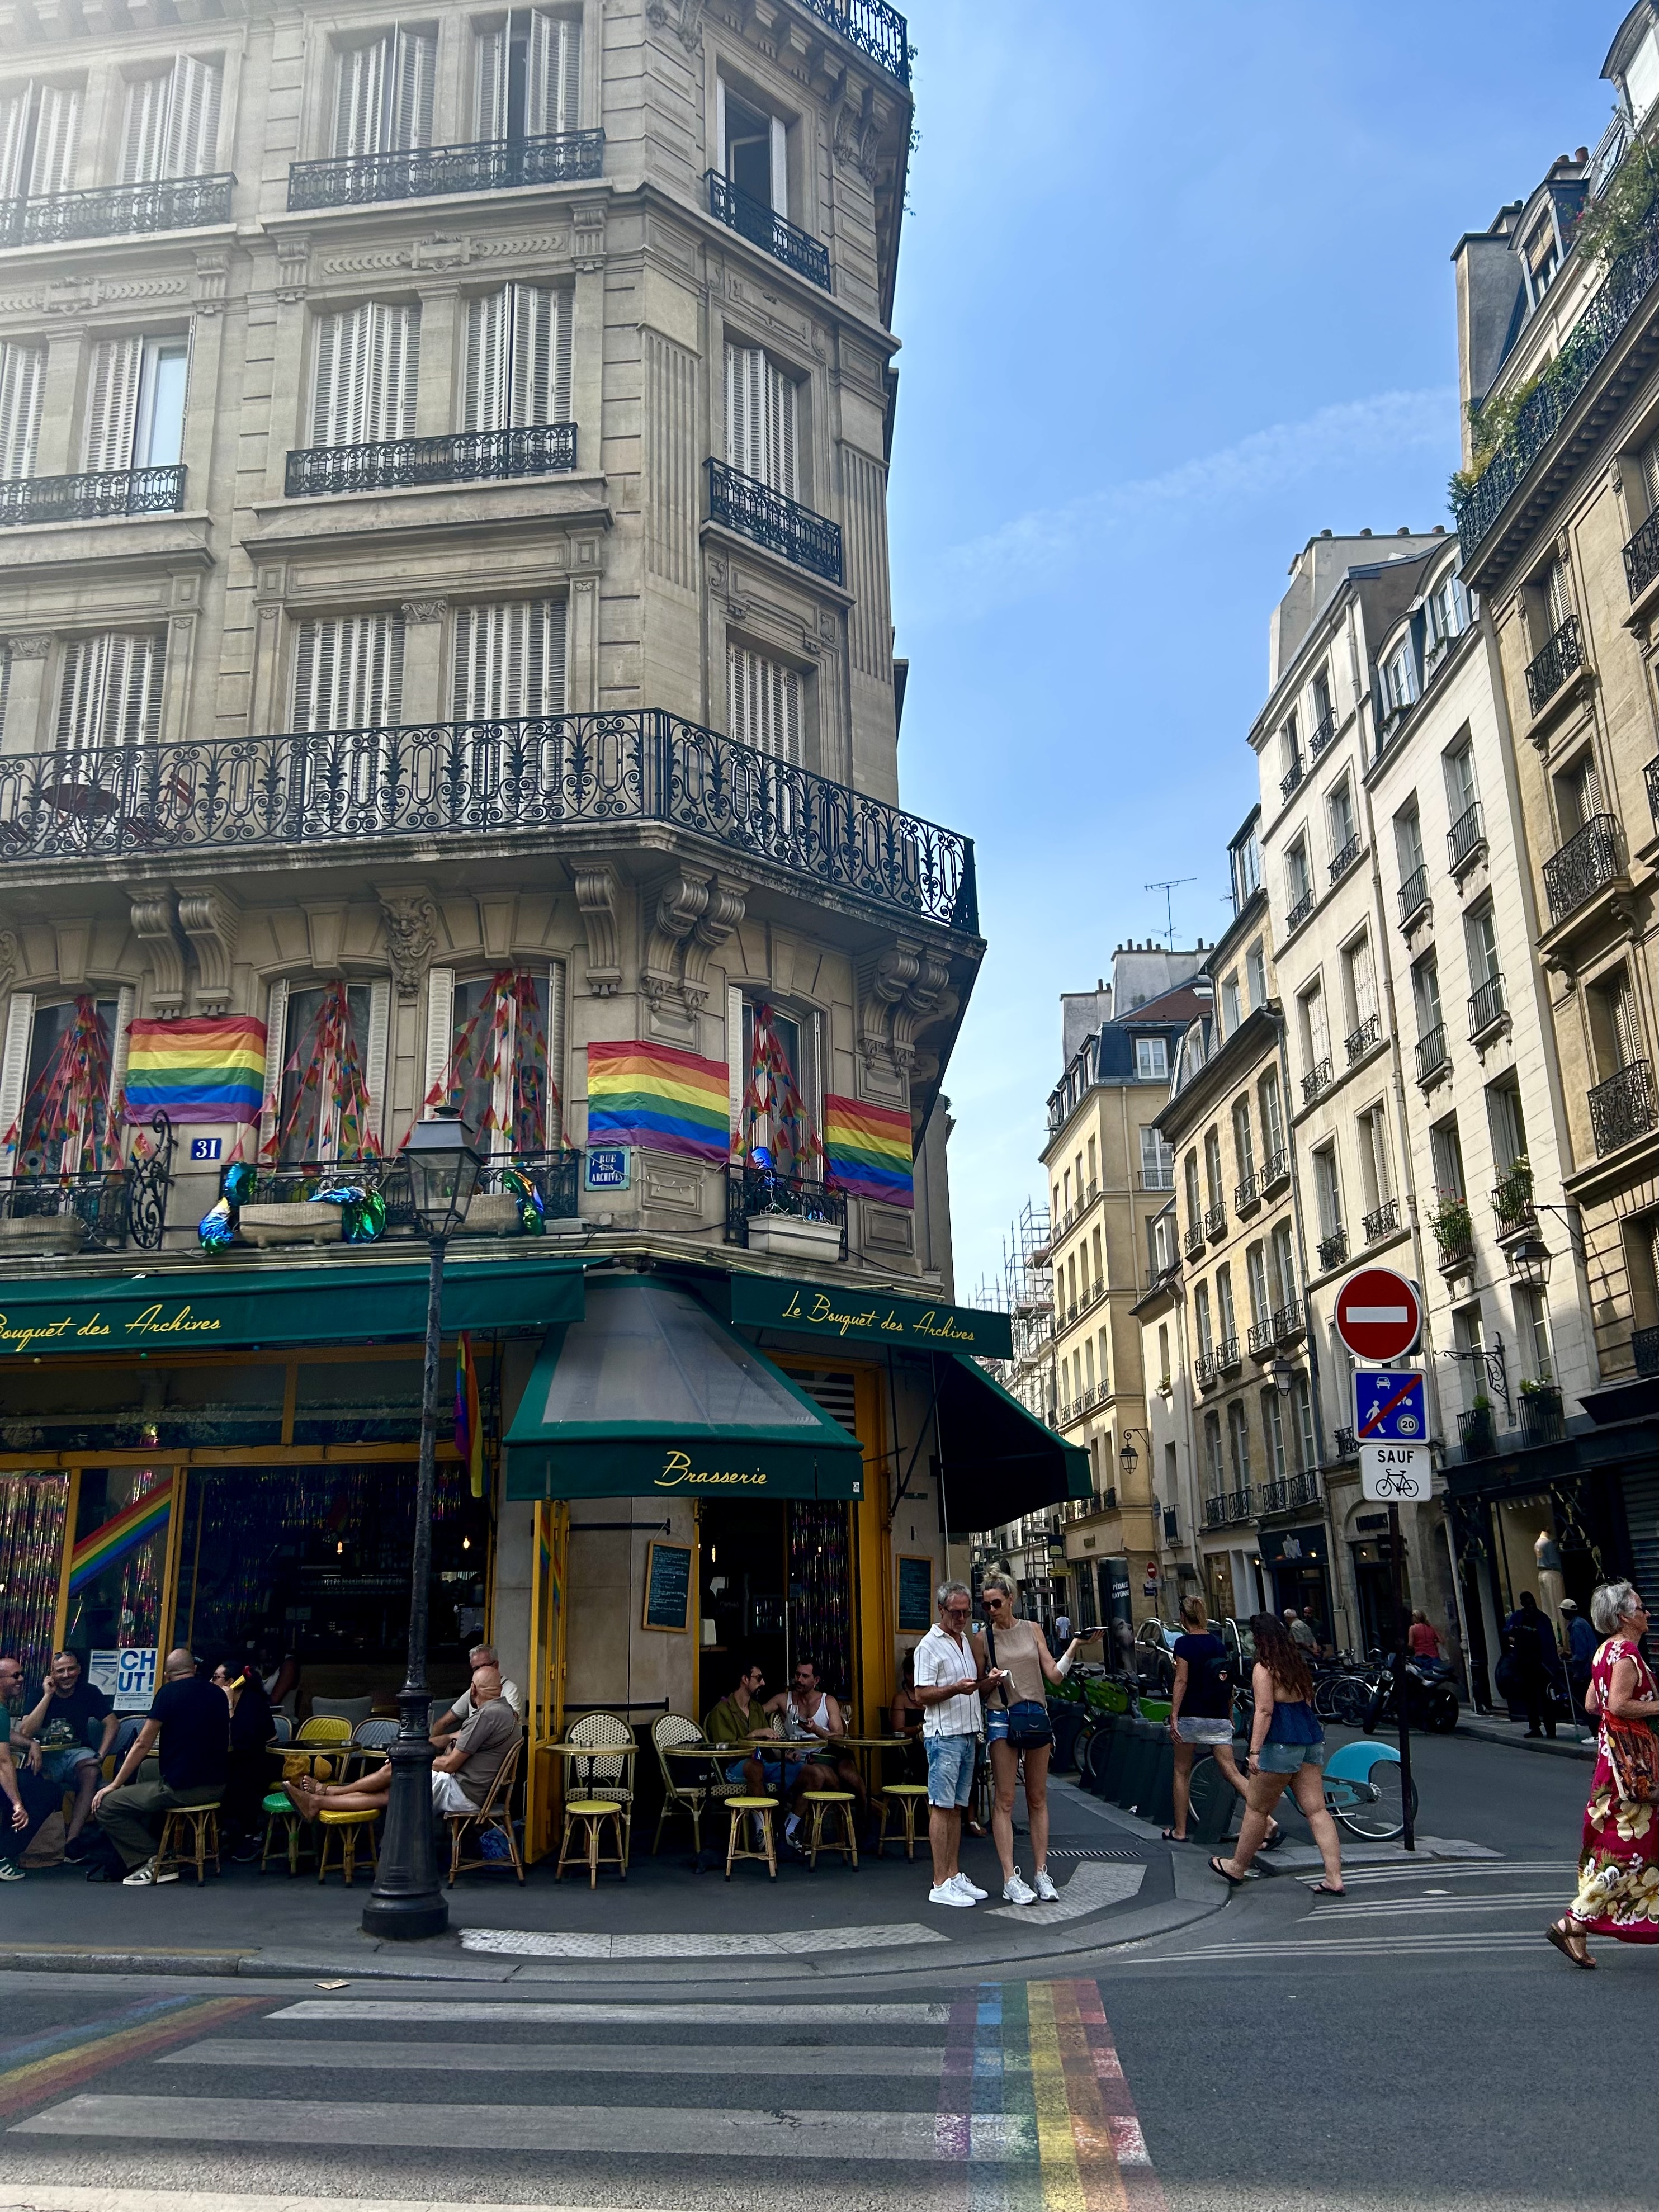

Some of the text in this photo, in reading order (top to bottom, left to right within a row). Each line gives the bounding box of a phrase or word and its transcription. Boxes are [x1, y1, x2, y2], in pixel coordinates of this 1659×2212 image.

[196, 1140, 218, 1158] 31
[599, 1154, 616, 1163] RUE
[592, 1173, 623, 1181] ARCHIVES
[77, 1313, 111, 1336] des
[125, 1304, 221, 1335] Archives
[782, 1291, 975, 1341] Le Bouquet des Archives
[1402, 1420, 1414, 1429] 20
[1377, 1449, 1415, 1463] SAUF
[654, 1450, 768, 1486] Brasserie
[121, 1650, 157, 1670] CH
[118, 1672, 154, 1692] UT!
